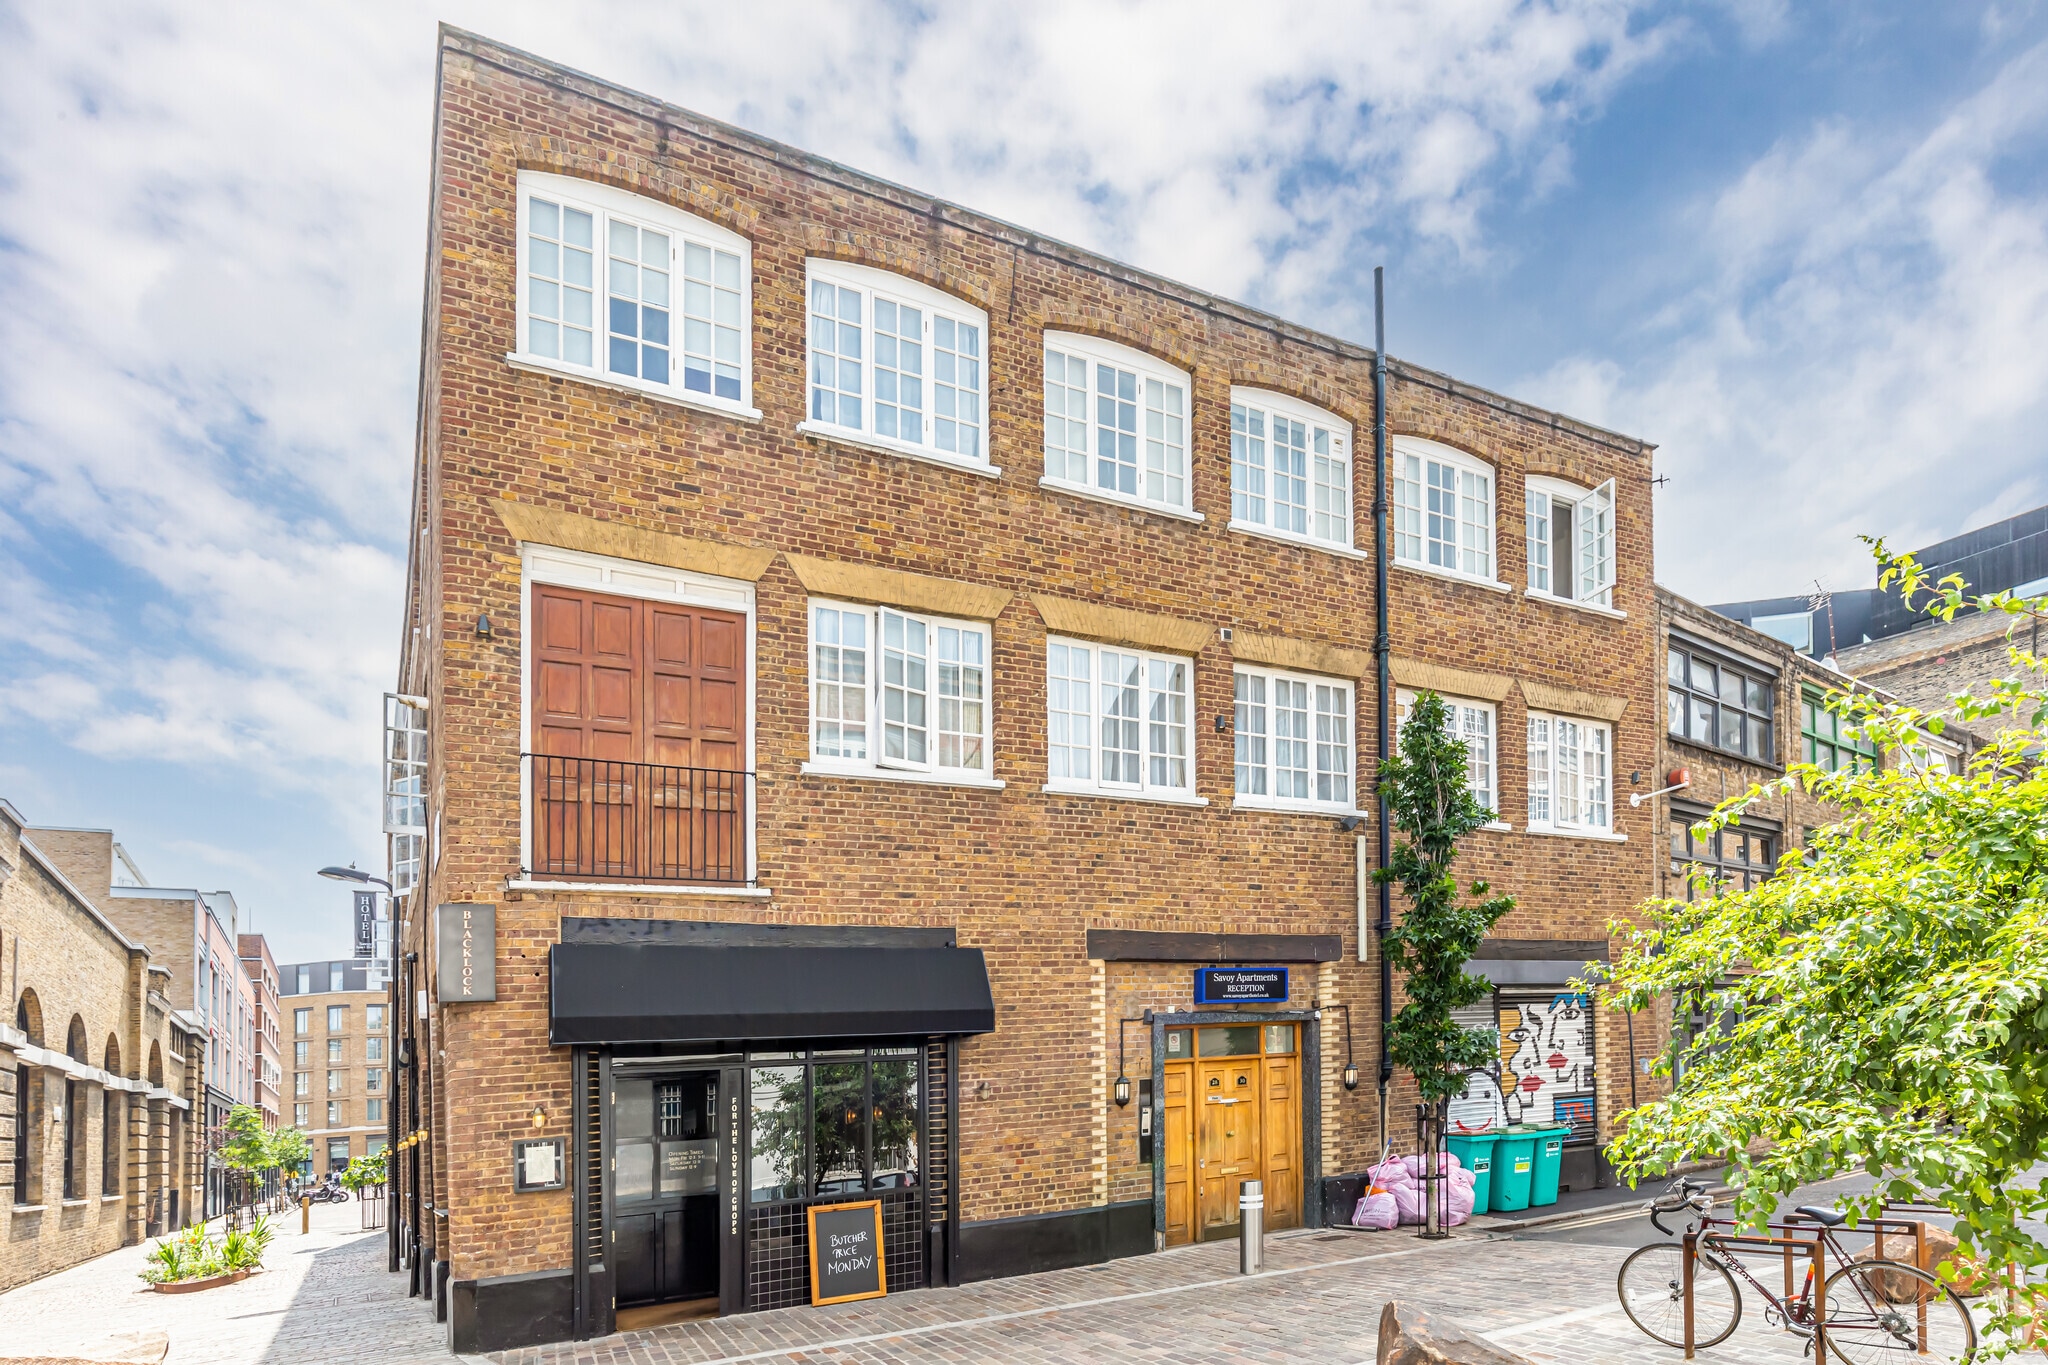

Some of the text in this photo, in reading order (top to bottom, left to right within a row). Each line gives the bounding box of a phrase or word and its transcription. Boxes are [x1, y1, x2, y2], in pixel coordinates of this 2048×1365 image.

[361, 896, 369, 939] HOTEL
[462, 910, 472, 995] BLACKLOCK
[1213, 972, 1278, 984] Savoy Apartments
[1227, 984, 1265, 993] RECEPTION
[731, 1179, 738, 1195] OF
[830, 1231, 868, 1246] BUTCHER
[832, 1245, 857, 1258] PRICE
[828, 1255, 872, 1275] MONDAY
[1719, 1250, 1752, 1282] PEUGEOT
